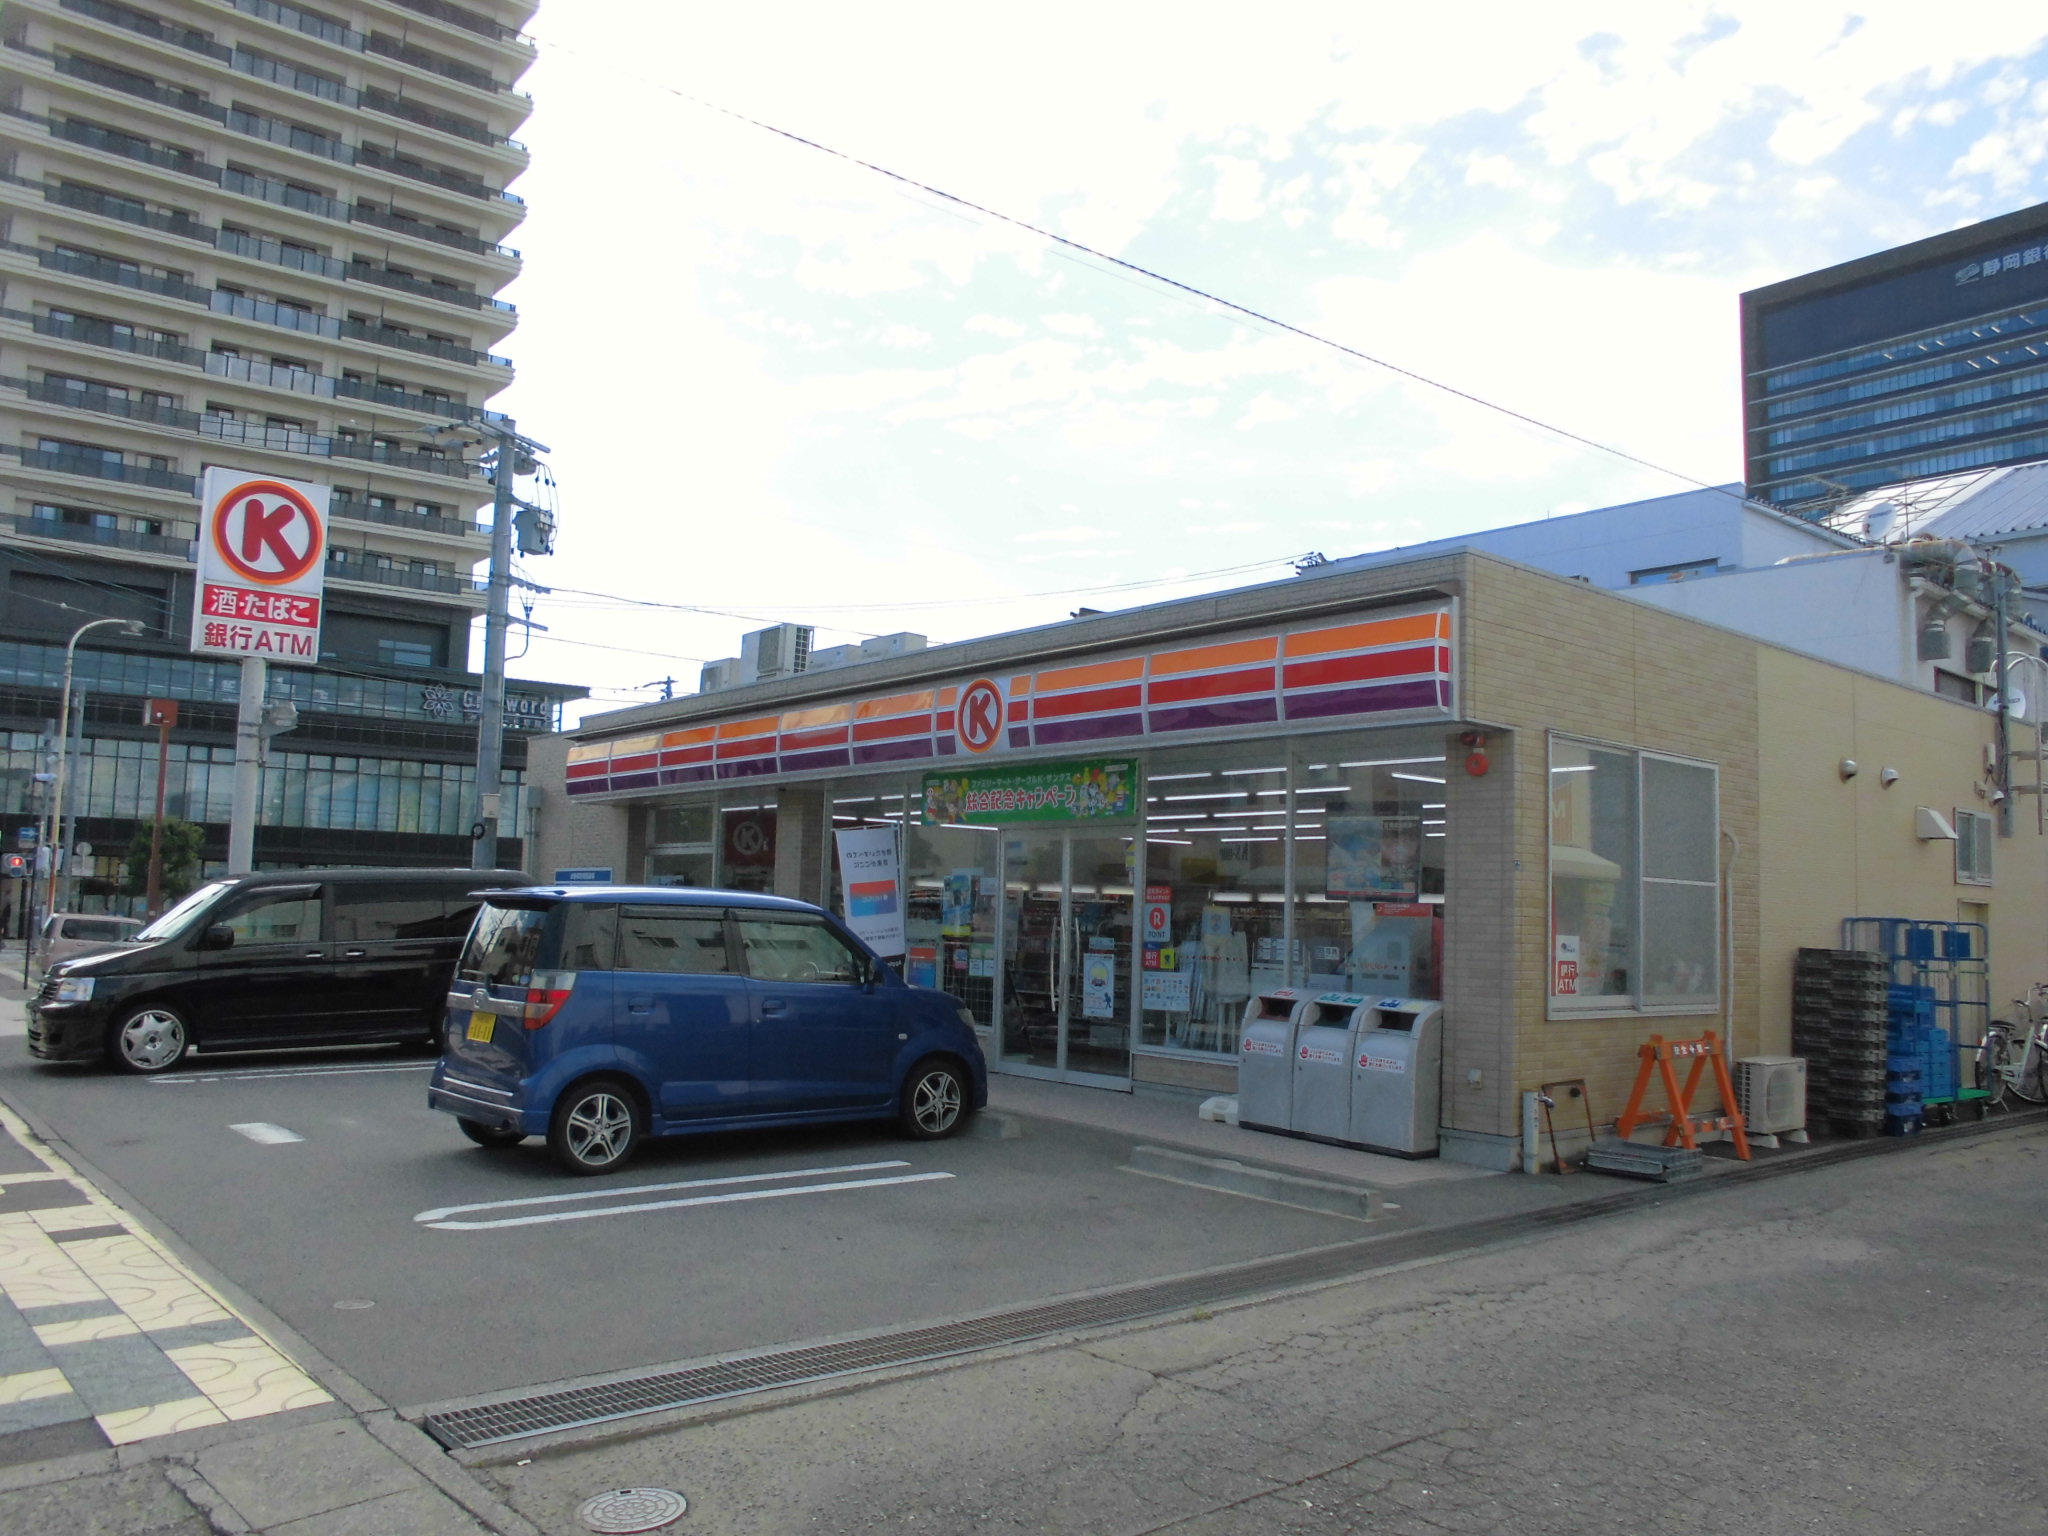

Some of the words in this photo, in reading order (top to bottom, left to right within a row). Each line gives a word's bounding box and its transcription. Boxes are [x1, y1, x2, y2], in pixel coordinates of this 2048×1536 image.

[204, 621, 313, 657] 銀行ATM
[965, 785, 1077, 812] 統合記念キャンペーン
[1558, 979, 1576, 991] ATM
